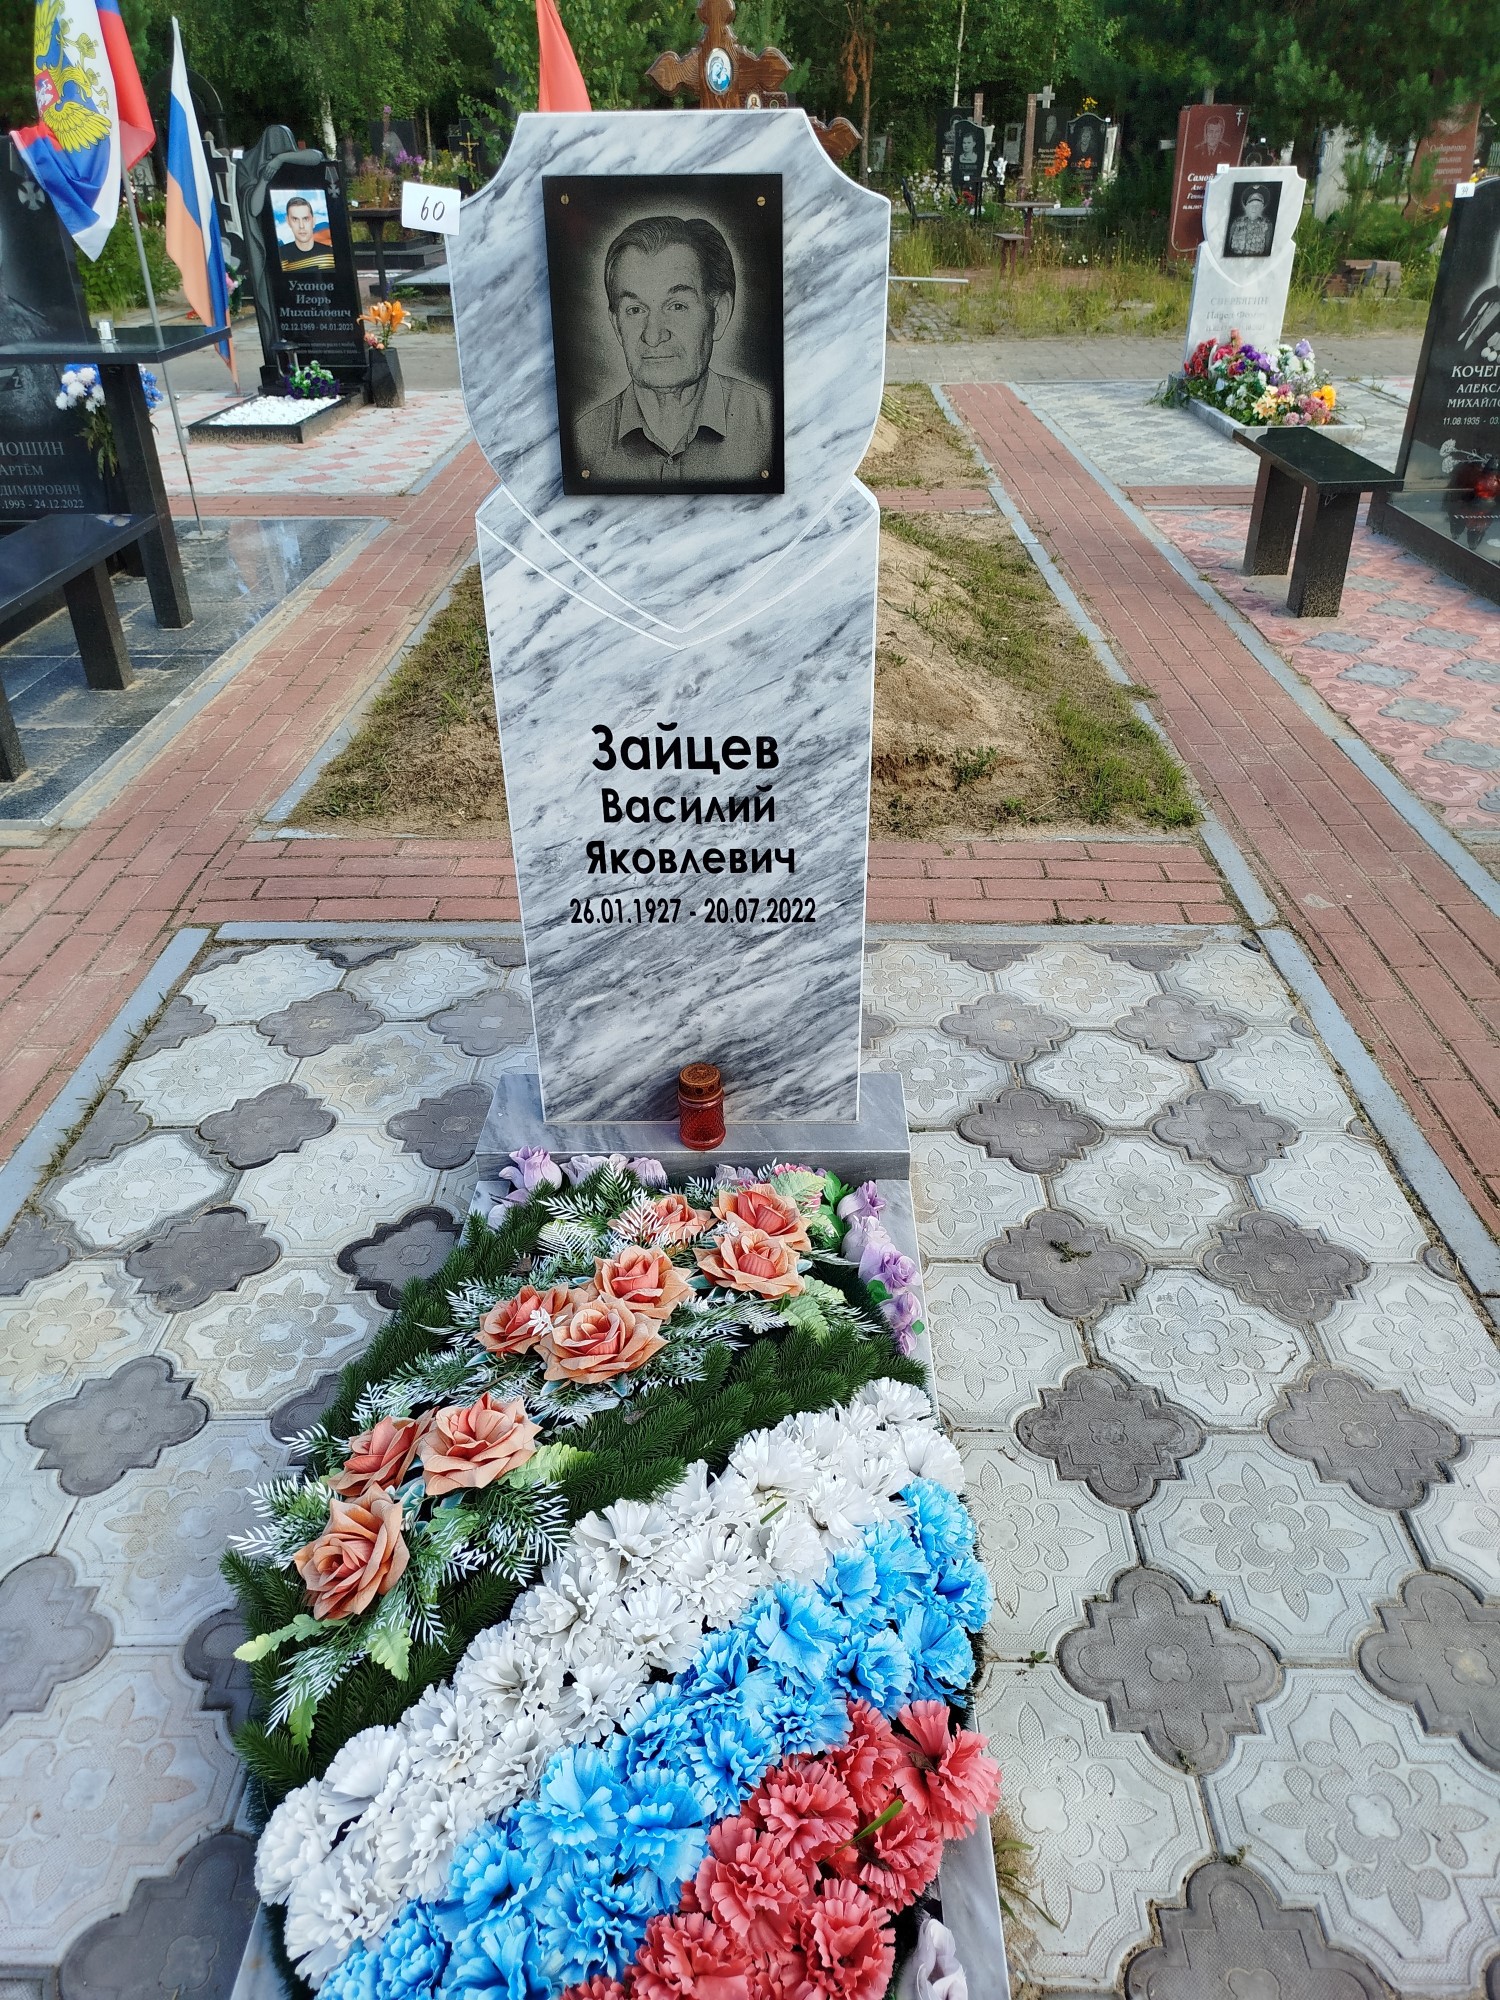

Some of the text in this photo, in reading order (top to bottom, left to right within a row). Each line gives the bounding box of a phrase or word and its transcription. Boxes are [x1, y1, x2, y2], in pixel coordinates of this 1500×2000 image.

[421, 196, 445, 221] 60
[288, 280, 335, 291] Уханов
[296, 294, 332, 306] Игорь
[280, 306, 352, 317] Михайлович
[320, 323, 354, 331] 04.01.2023
[35, 499, 85, 509] 24.12.2022
[591, 722, 779, 775] Зайцев
[601, 784, 775, 824] Василий
[586, 840, 795, 875] Яковлевич
[569, 898, 681, 924] 26.01.1927
[704, 898, 816, 924] 20.07.2022
